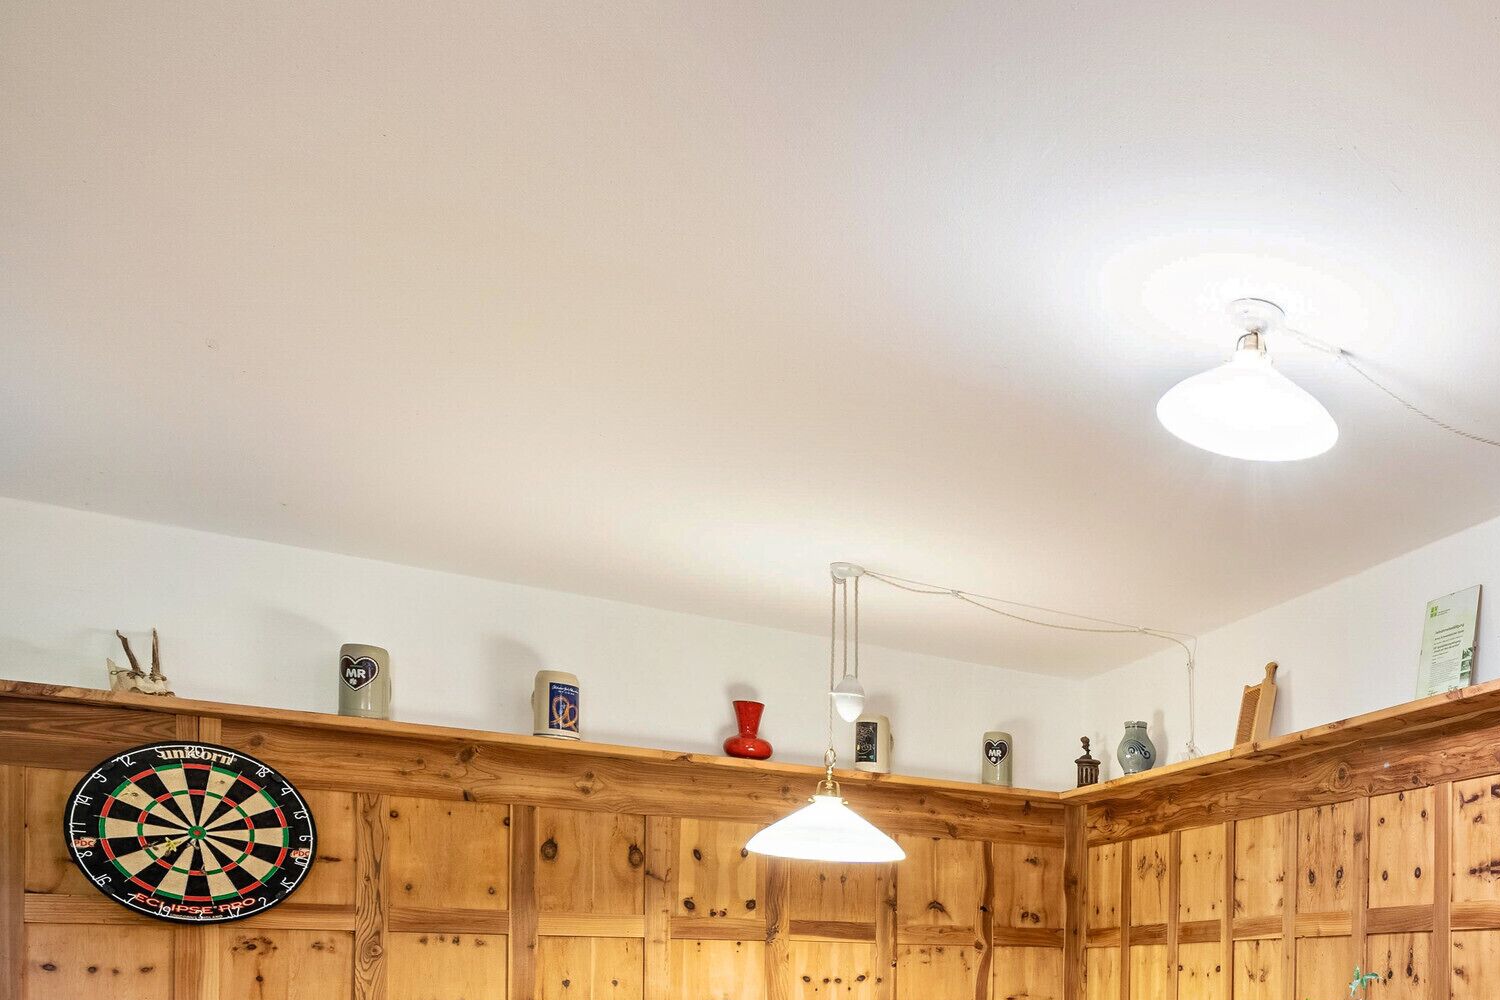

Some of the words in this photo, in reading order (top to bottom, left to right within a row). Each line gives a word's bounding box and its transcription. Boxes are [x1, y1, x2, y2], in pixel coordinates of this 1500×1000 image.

[346, 668, 366, 679] MR
[161, 748, 233, 766] unicorn
[186, 746, 204, 758] 20
[988, 749, 1001, 757] MR
[120, 756, 136, 767] 12
[256, 766, 269, 778] 18
[73, 839, 95, 847] PDC
[134, 892, 213, 914] ECLIPSE
[220, 897, 256, 913] PRO
[258, 897, 267, 907] 2
